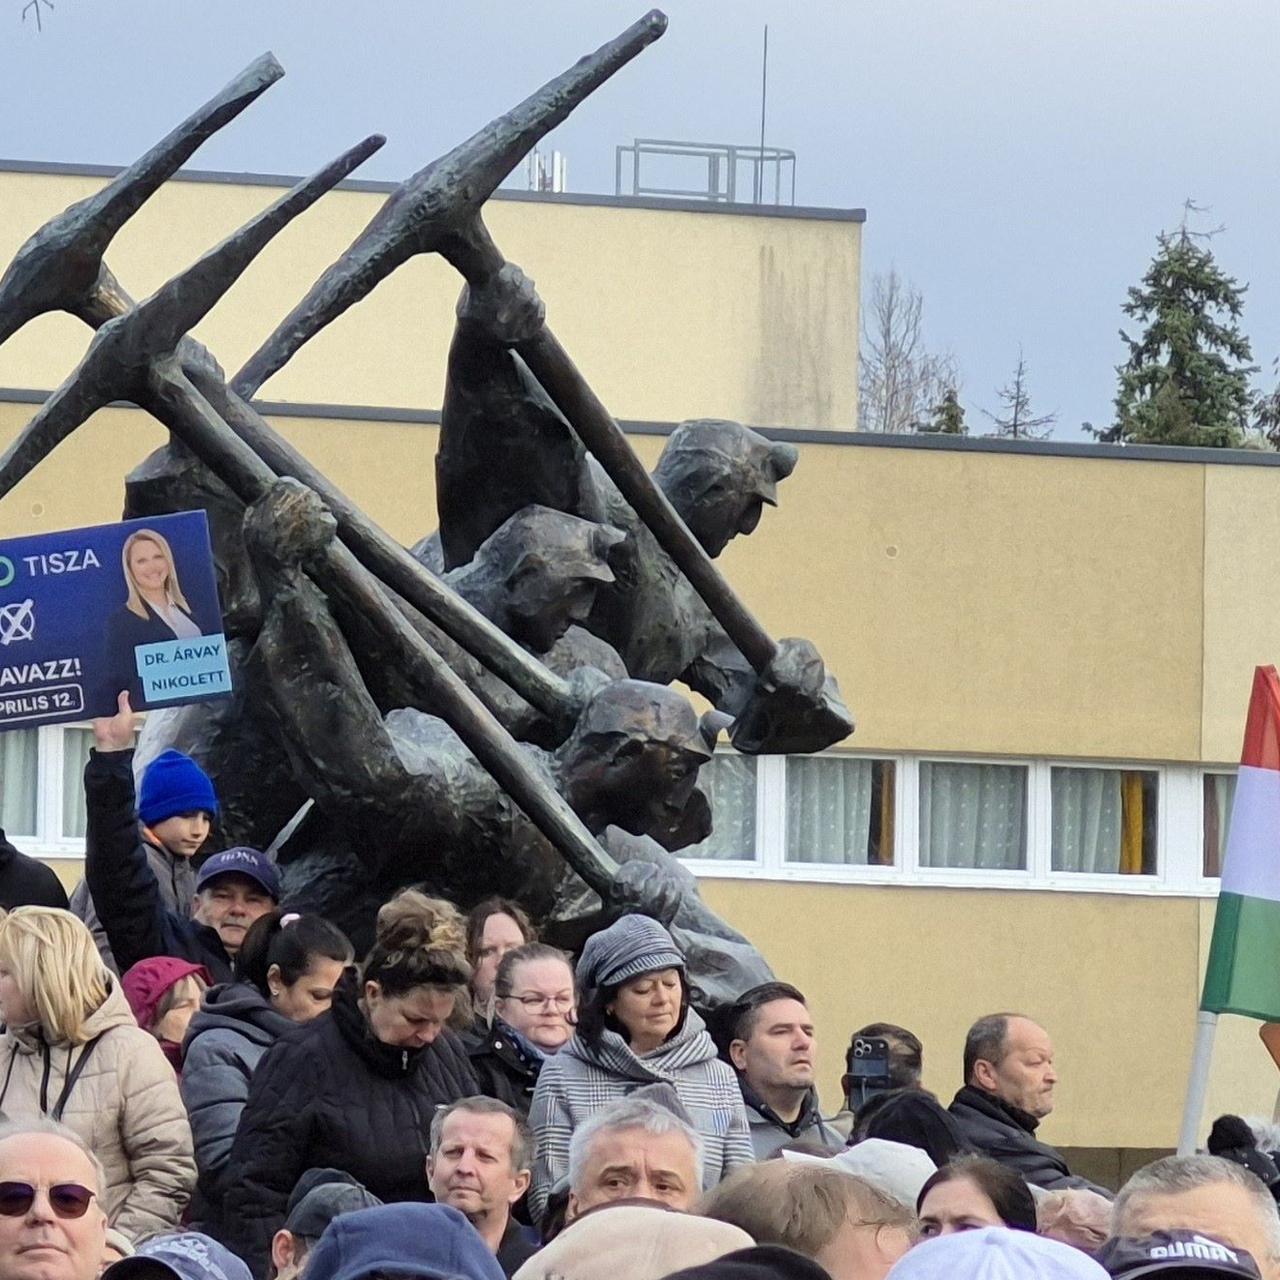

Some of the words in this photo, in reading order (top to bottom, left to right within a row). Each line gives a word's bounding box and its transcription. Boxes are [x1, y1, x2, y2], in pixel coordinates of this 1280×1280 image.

[23, 549, 101, 577] TISZA
[144, 652, 169, 667] DR.
[173, 644, 222, 662] ÁRVAY
[151, 670, 225, 692] NIKOLETT
